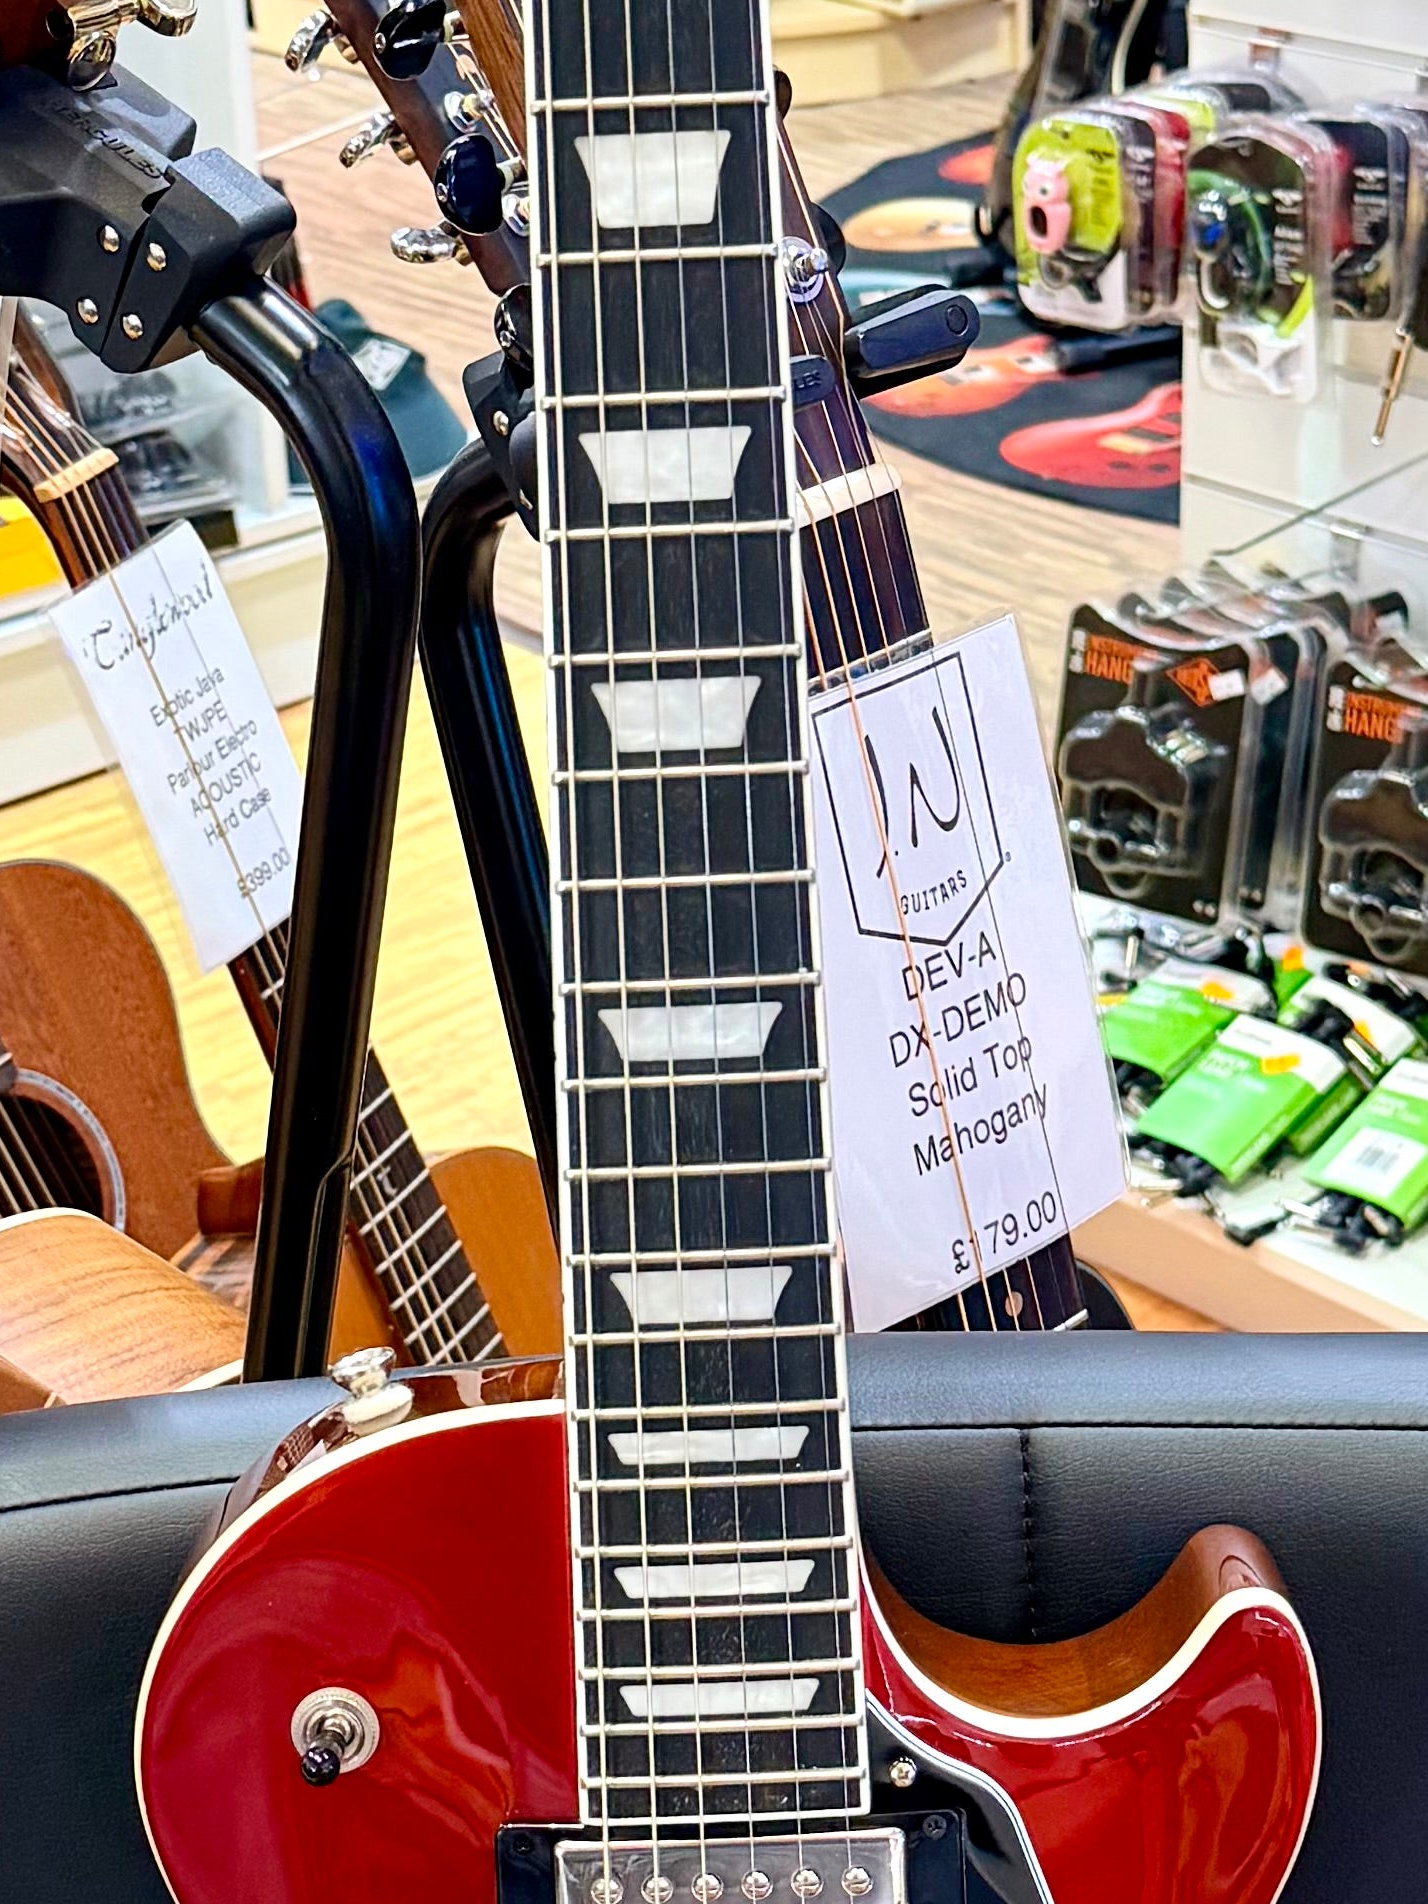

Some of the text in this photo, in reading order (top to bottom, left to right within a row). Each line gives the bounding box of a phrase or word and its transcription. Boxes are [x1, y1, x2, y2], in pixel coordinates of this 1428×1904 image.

[149, 666, 225, 729] Exotic Java
[166, 717, 258, 796] Parlour Electro
[190, 751, 263, 819] ACOUSTIC
[203, 787, 272, 848] Hard Case
[237, 847, 291, 900] £399.00
[899, 869, 968, 916] GUITARS
[901, 930, 997, 1001] DEV-A
[888, 971, 1028, 1069] DX-DEMO
[908, 1034, 1033, 1117] Solid Top
[912, 1082, 1048, 1177] Mahogany
